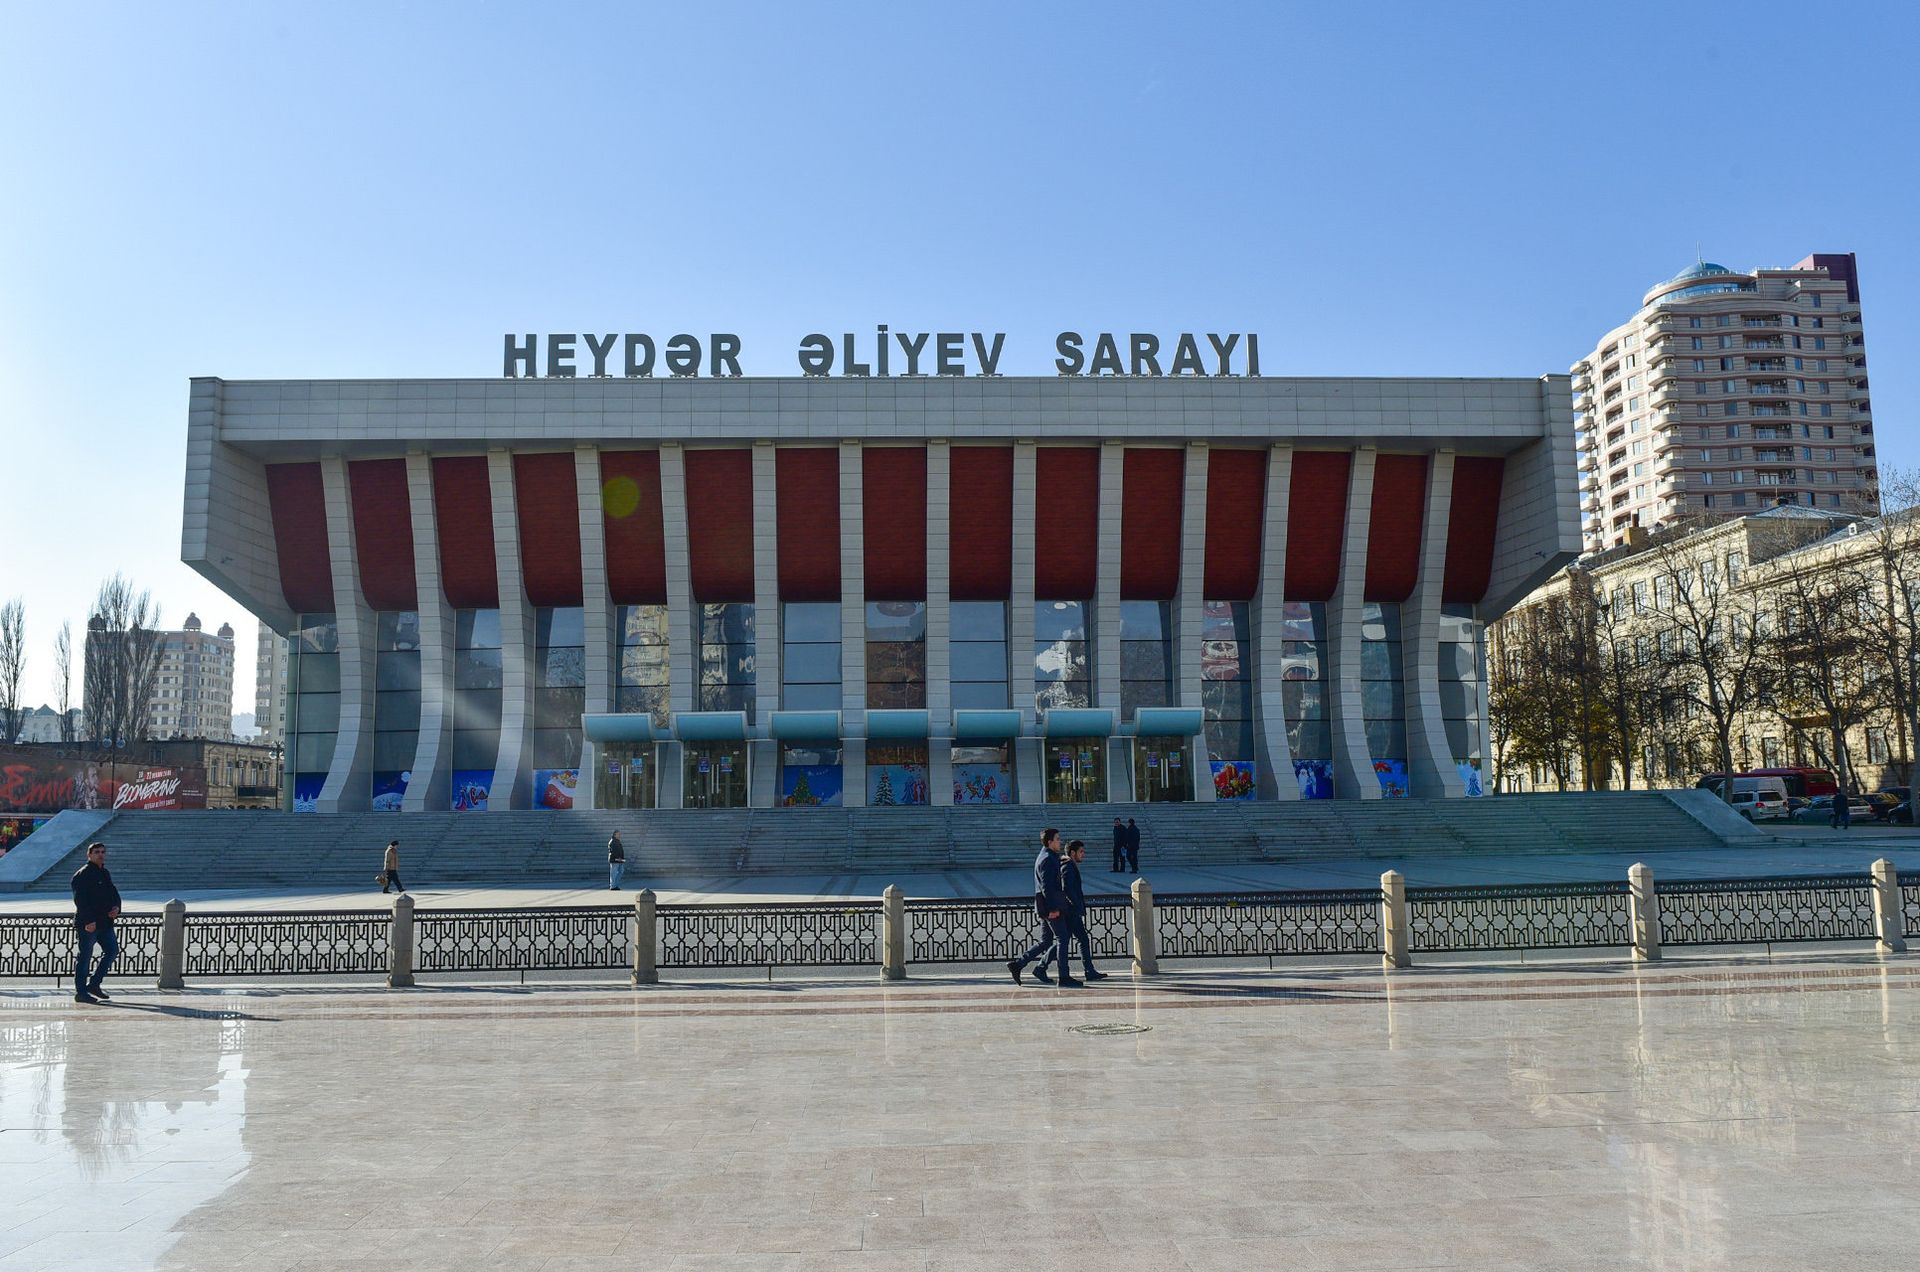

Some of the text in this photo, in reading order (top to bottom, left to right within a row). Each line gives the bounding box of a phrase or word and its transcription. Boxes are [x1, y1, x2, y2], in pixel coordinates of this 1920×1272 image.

[504, 324, 1260, 377] HEYDƏR ƏLİYEV SARAYI
[112, 777, 181, 810] BOOMERANG
